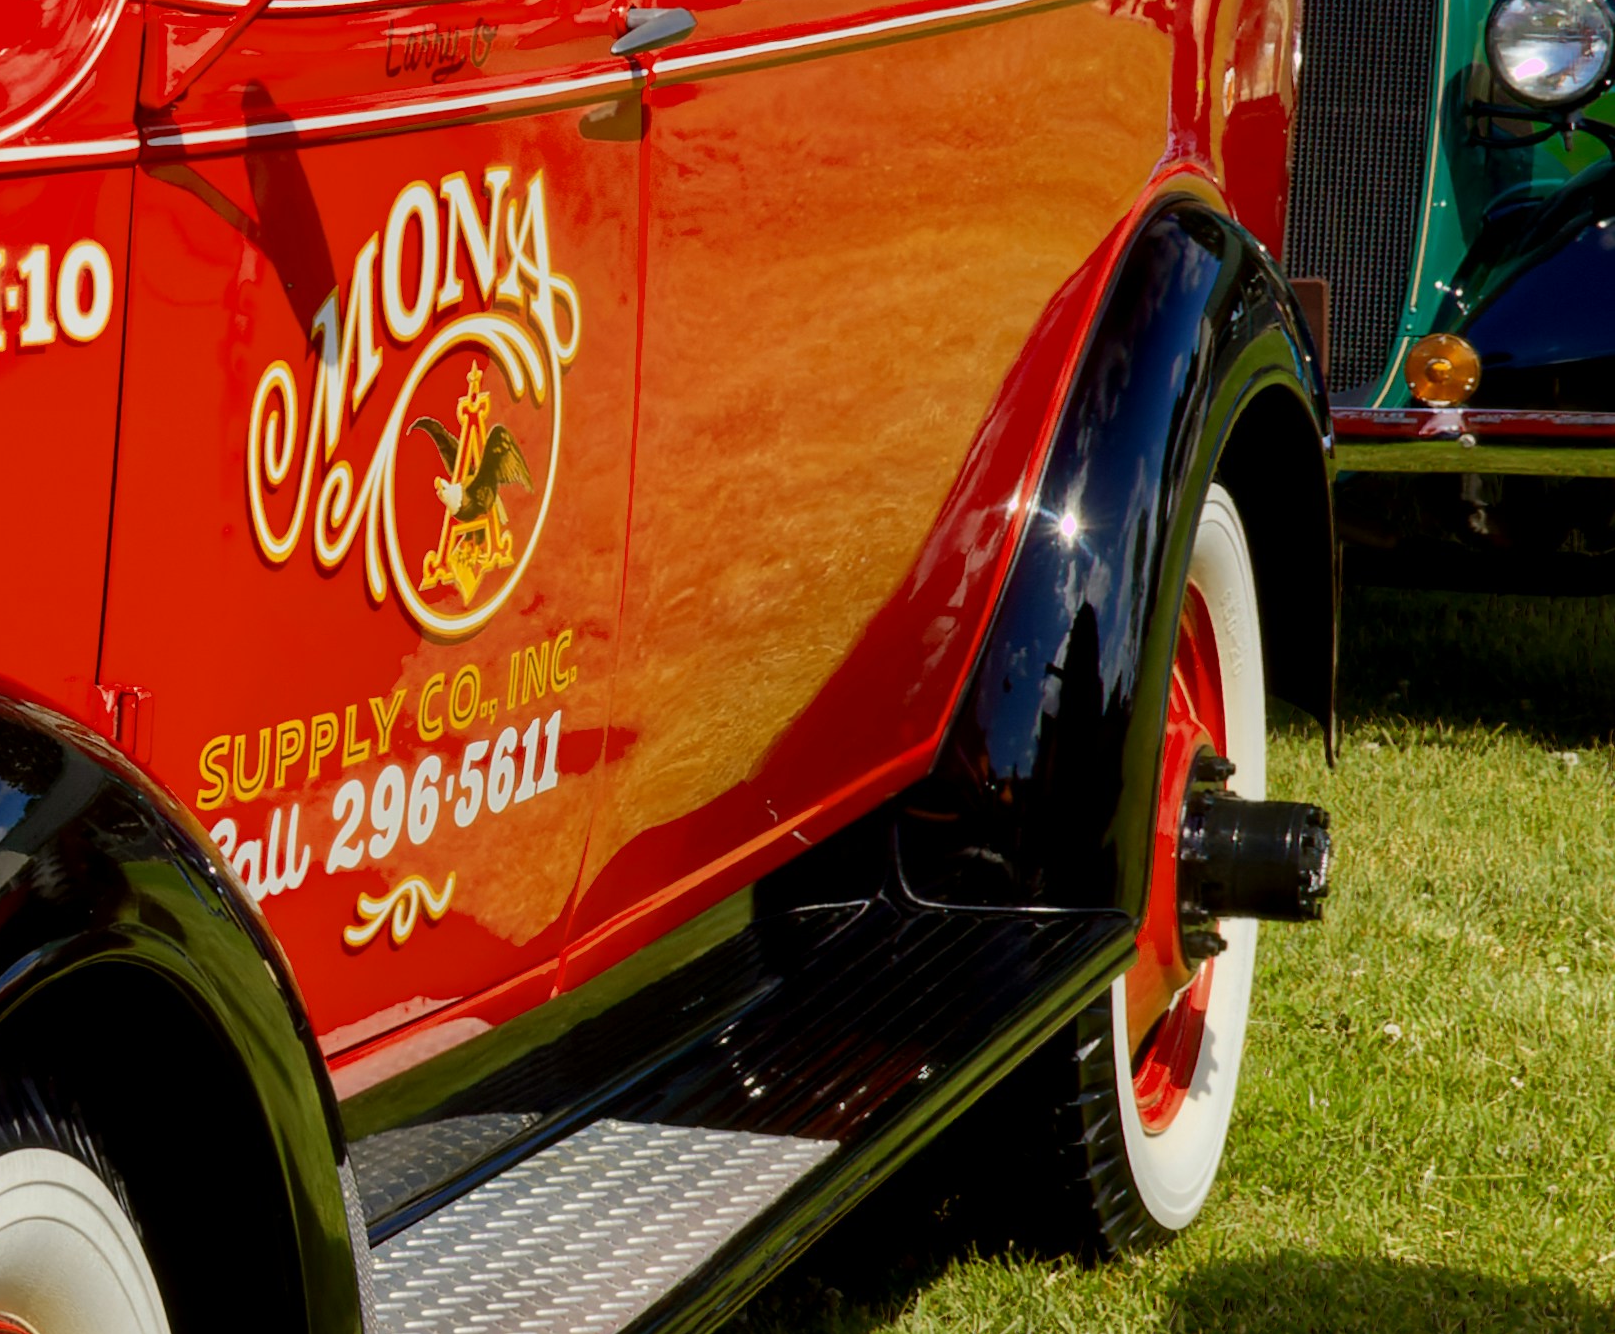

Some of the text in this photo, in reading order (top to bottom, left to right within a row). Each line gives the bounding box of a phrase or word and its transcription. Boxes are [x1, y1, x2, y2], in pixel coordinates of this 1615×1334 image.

[248, 166, 581, 563] MONA
[196, 689, 408, 811] SUPPLY
[506, 628, 578, 711] INC.
